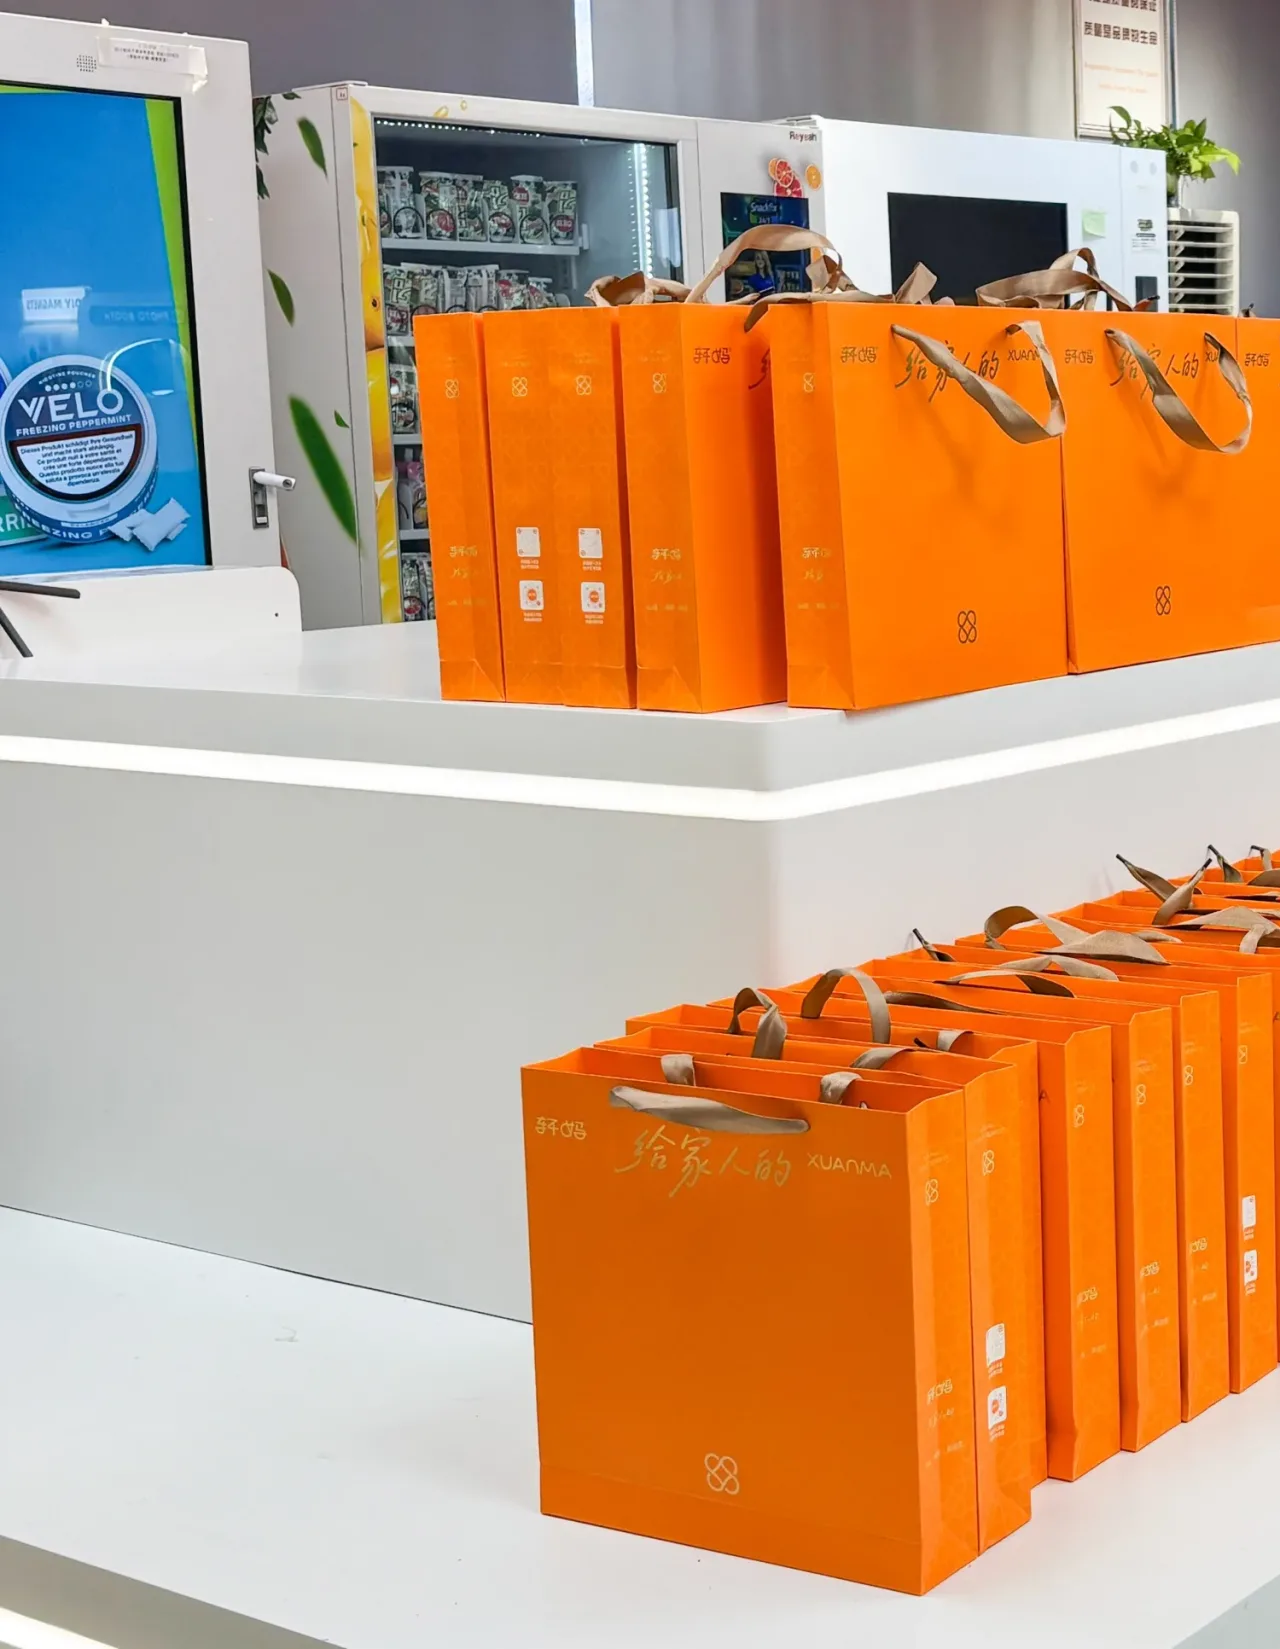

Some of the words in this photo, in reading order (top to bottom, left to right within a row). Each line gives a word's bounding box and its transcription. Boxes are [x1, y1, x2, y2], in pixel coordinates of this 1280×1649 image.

[1084, 21, 1157, 45] 质量是品牌的生命
[841, 346, 878, 364] 轩妈
[1064, 349, 1094, 365] 轩妈
[1244, 353, 1270, 367] 轩妈
[18, 388, 124, 425] VELO
[16, 423, 66, 437] FREEZING
[69, 414, 132, 430] PEPPERMINT
[534, 1116, 588, 1140] 轩妈
[614, 1125, 792, 1198] 给家人的
[806, 1152, 893, 1180] XUANMA
